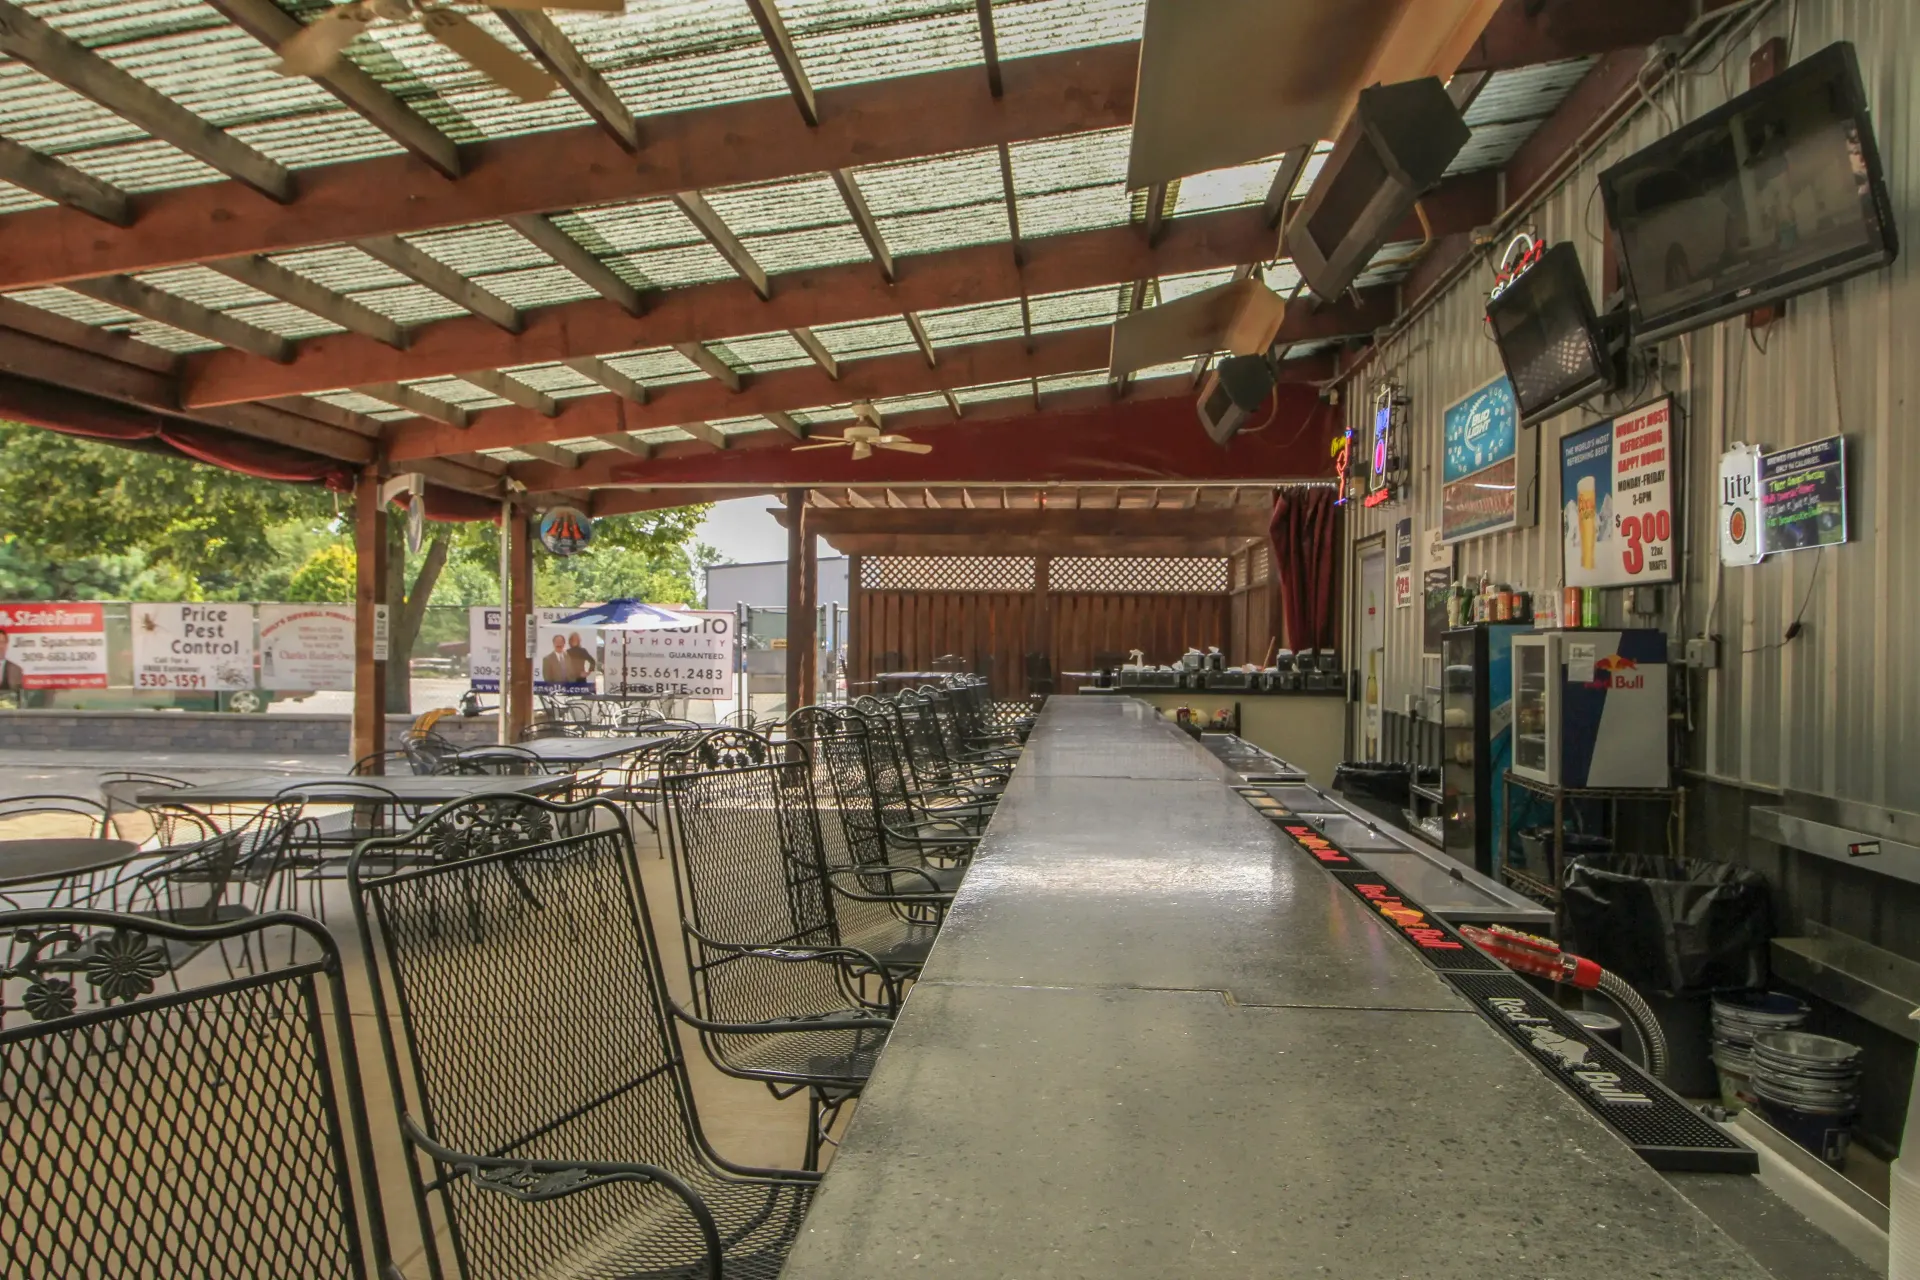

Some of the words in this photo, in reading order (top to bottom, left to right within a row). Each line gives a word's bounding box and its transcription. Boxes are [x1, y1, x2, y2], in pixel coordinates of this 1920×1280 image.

[1472, 408, 1490, 426] BUD
[1616, 416, 1645, 438] WORLD'S
[1647, 407, 1668, 427] MOST
[1467, 418, 1491, 440] LIGHT
[1620, 429, 1662, 454] REFRESHING
[1618, 455, 1639, 473] HAPPY
[1618, 470, 1665, 492] MONDAY-FRIDAY
[1723, 473, 1752, 506] Lite
[1632, 491, 1652, 505] 3-6PM
[181, 606, 227, 622] Price
[184, 623, 224, 638] Pest
[171, 640, 239, 654] Control
[611, 636, 726, 647] AUTHORITY
[140, 673, 206, 688] 530-1591
[1615, 674, 1644, 689] Bull
[1488, 997, 1550, 1024] Red
[1573, 1071, 1653, 1106] Bull
